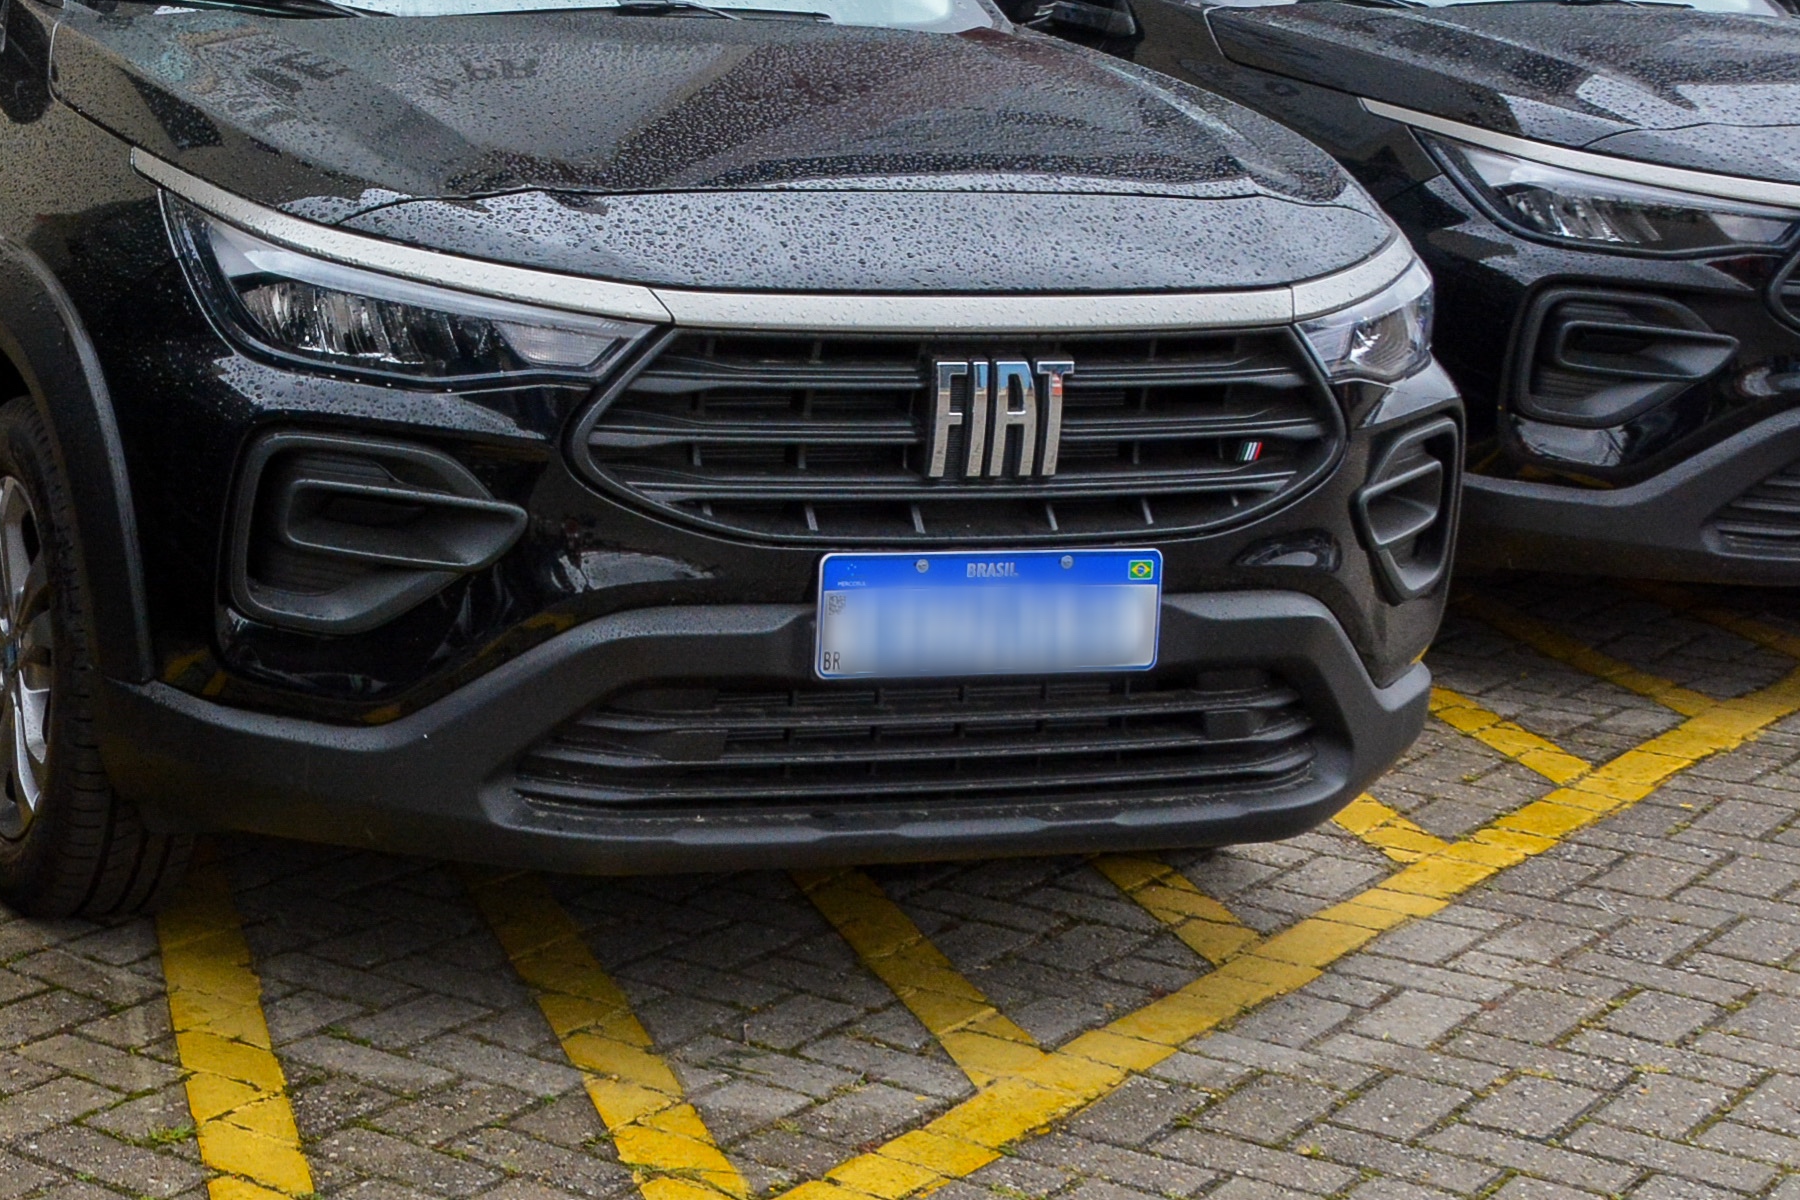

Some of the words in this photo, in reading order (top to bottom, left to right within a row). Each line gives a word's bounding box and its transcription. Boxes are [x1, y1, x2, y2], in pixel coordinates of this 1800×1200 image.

[928, 360, 1075, 478] FIAT
[966, 561, 1019, 578] BRASIL
[823, 651, 841, 671] BR
